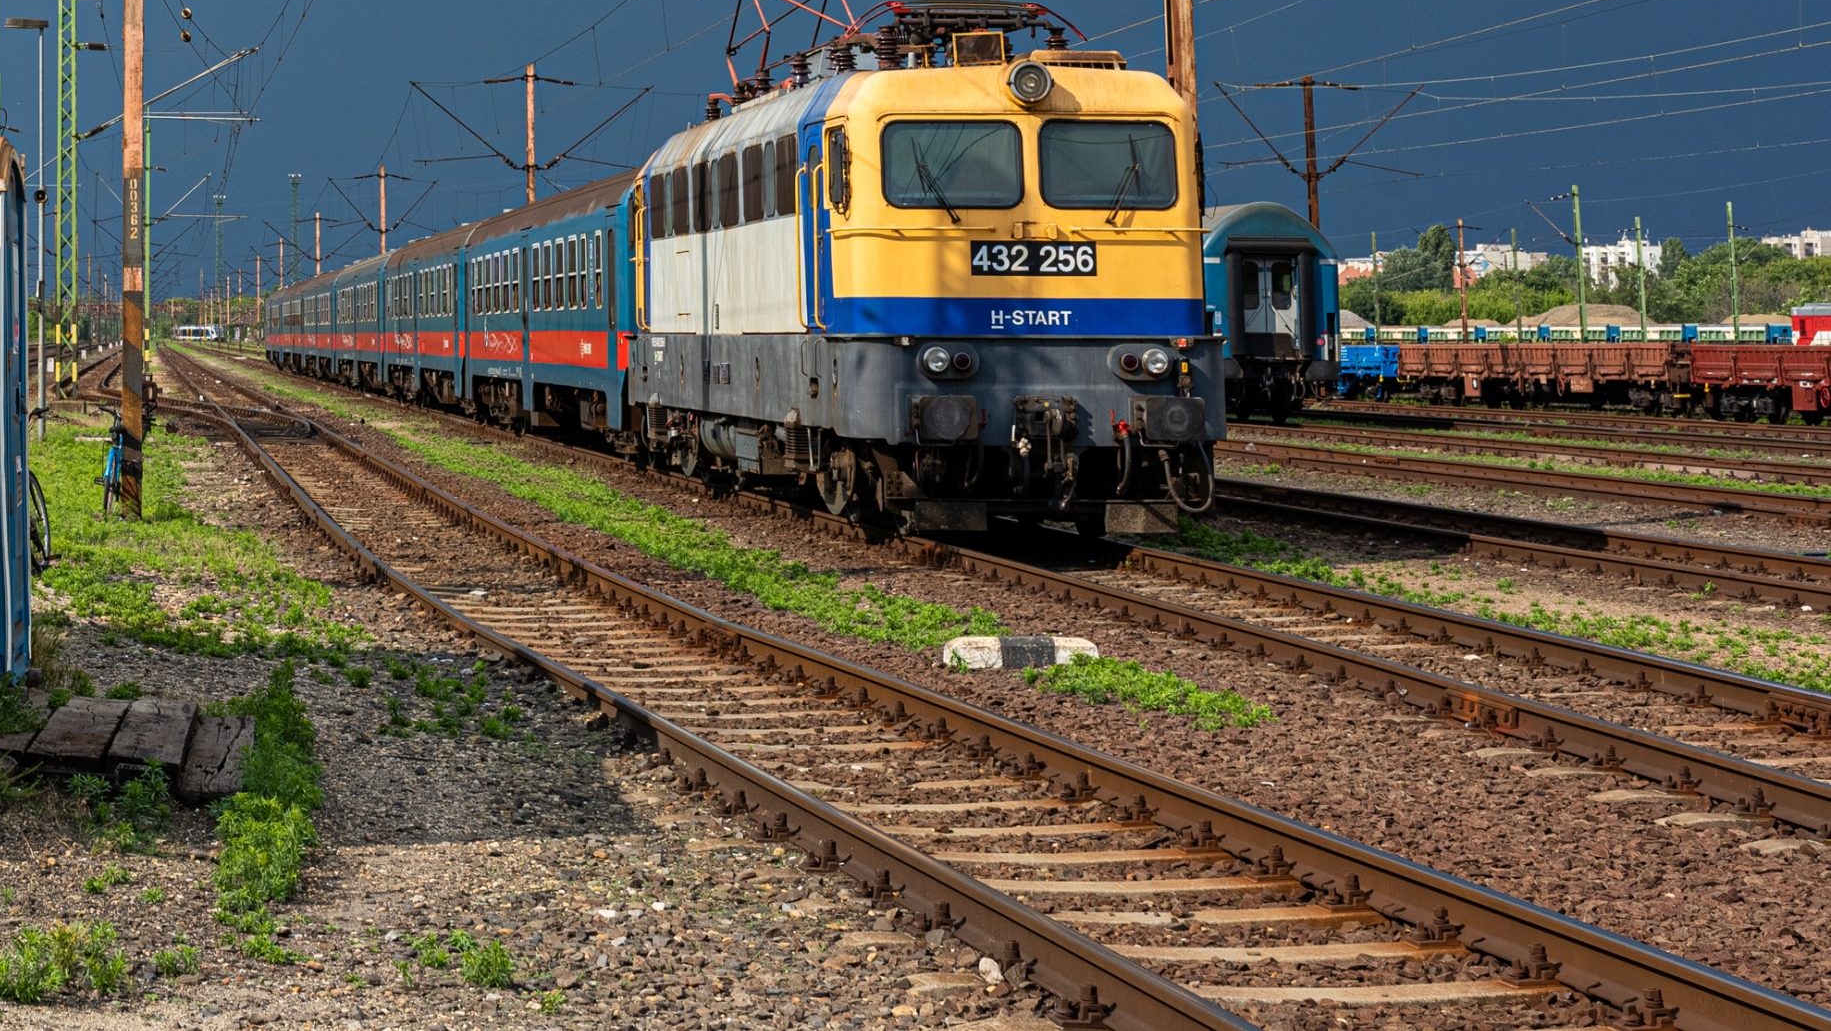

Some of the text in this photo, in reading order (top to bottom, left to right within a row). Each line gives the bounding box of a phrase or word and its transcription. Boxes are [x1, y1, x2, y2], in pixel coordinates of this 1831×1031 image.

[129, 178, 138, 240] 00362
[972, 245, 1094, 273] 432 256
[991, 310, 1072, 329] H-START
